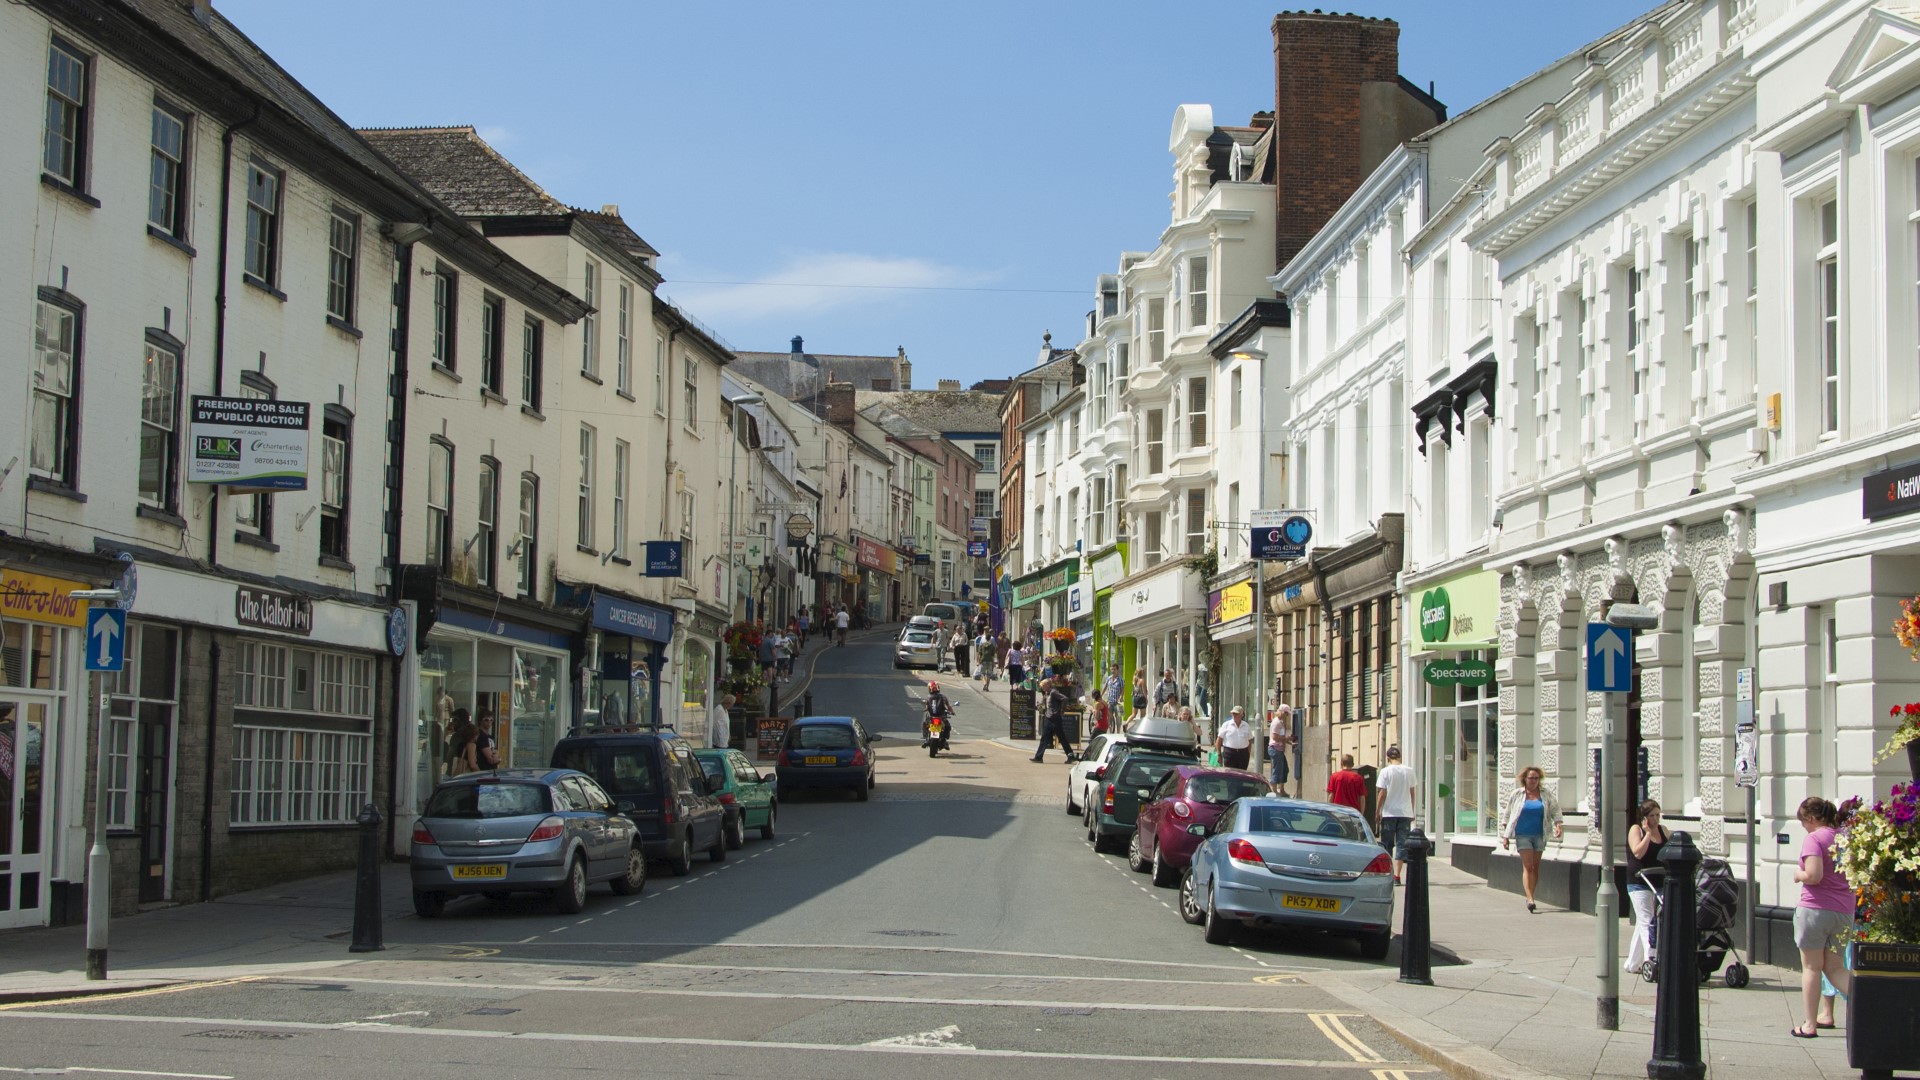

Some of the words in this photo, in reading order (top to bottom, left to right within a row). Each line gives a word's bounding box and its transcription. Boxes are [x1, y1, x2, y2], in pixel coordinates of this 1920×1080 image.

[198, 399, 252, 411] FREEHOLD
[255, 403, 276, 412] FOR
[278, 405, 305, 414] SALE
[198, 411, 213, 420] BY
[215, 412, 254, 422] PUBLIC
[256, 415, 303, 426] AUCTION
[196, 460, 216, 468] 01237
[239, 590, 259, 622] The
[261, 593, 293, 628] Talbot
[294, 600, 310, 630] Inn
[1422, 604, 1445, 629] Specsavers
[609, 606, 627, 624] CANCER
[627, 611, 647, 628] RESEARCH
[1430, 667, 1487, 680] Specsavers
[760, 720, 786, 730] HARTS
[484, 866, 502, 875] UEN
[1286, 896, 1314, 907] PK57
[1315, 898, 1336, 909] XDR
[1865, 951, 1920, 964] BIDEFOR
